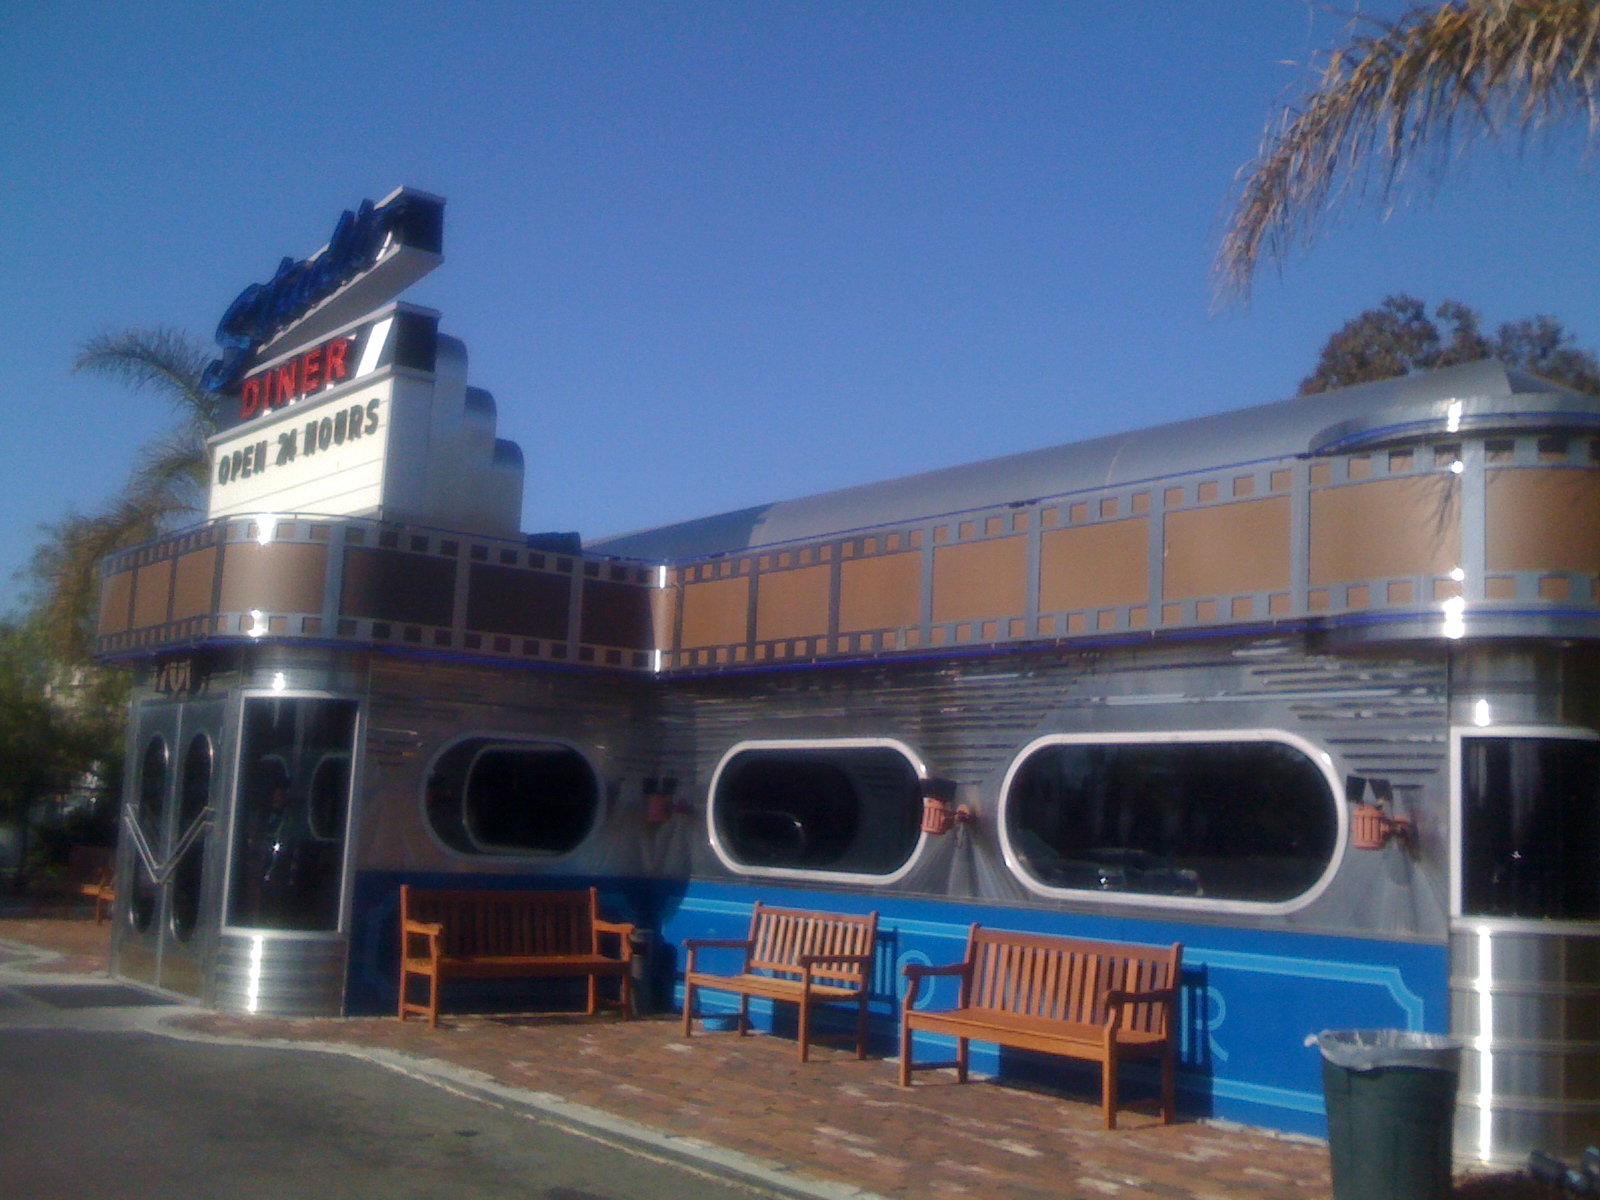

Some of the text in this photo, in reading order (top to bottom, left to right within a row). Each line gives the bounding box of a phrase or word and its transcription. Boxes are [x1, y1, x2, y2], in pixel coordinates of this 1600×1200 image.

[241, 337, 349, 419] DINER
[218, 398, 380, 485] OPEN 24 HOURS
